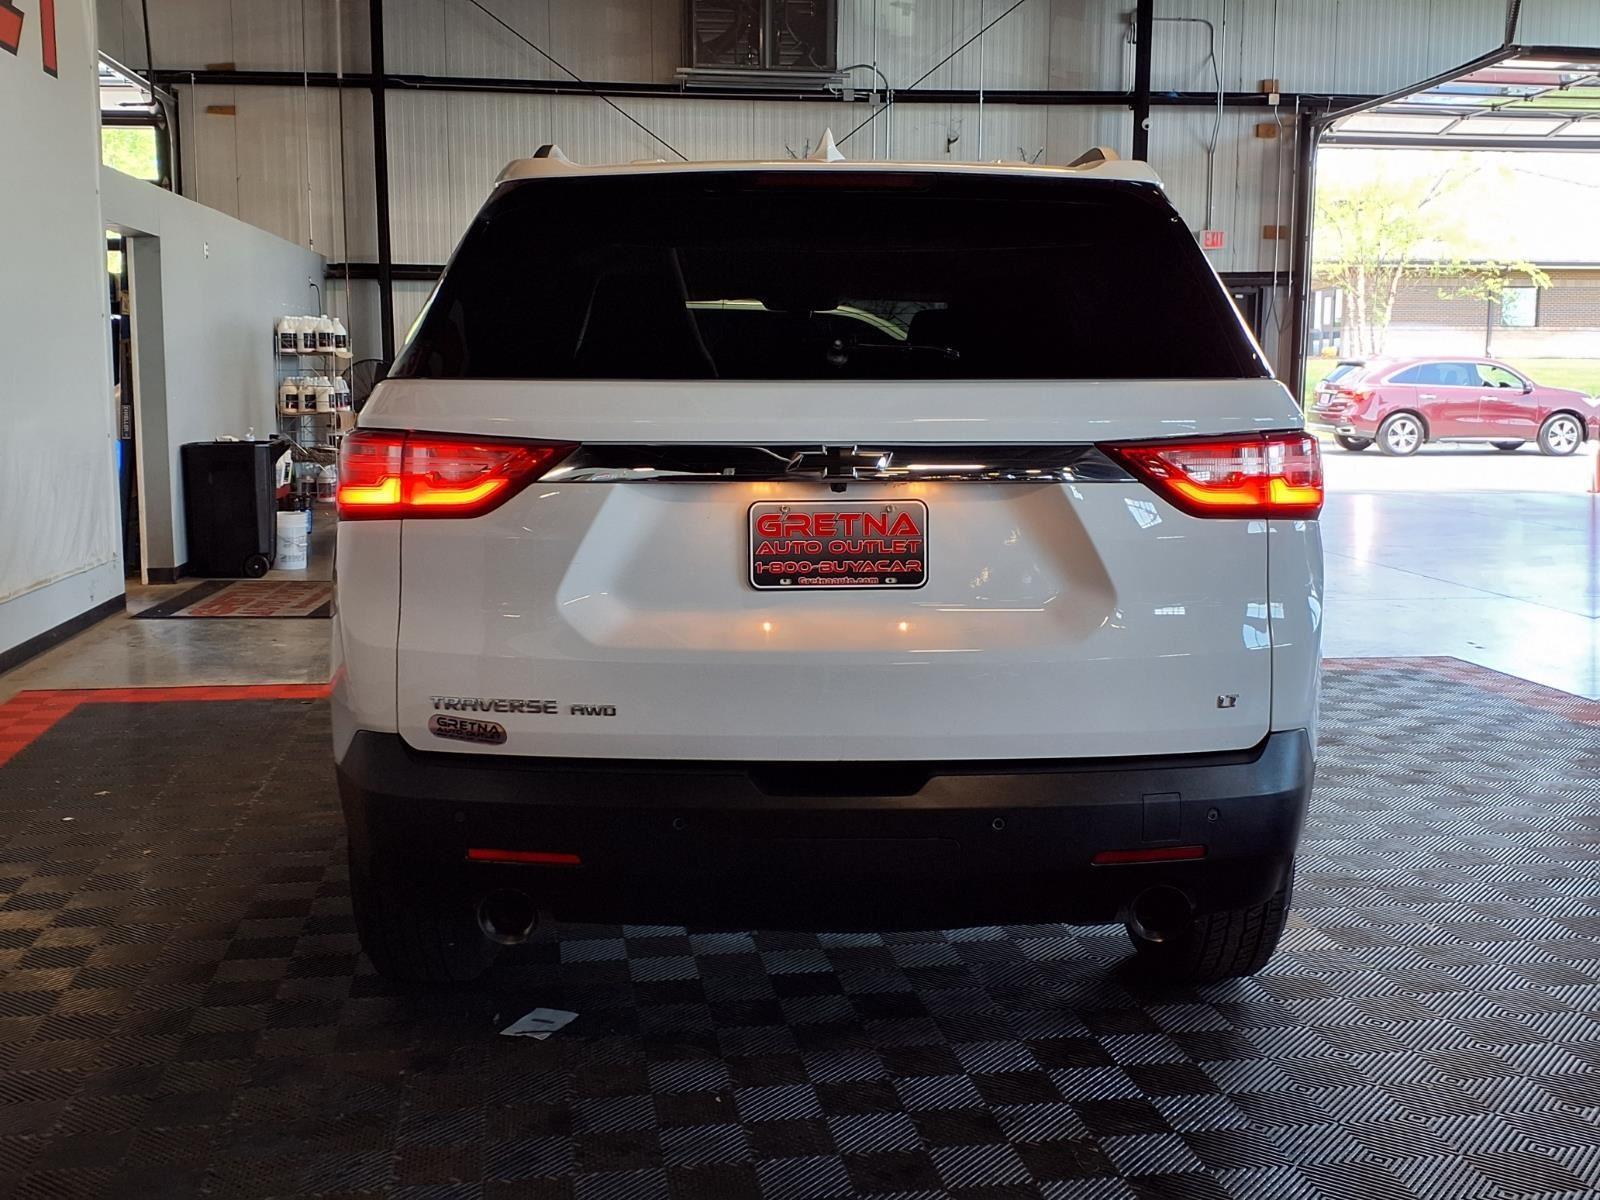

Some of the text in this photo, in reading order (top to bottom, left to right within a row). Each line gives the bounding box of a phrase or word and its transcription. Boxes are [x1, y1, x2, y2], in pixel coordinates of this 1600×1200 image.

[1204, 231, 1225, 247] EXIT
[755, 511, 921, 538] GRETNA
[755, 538, 922, 555] AUTO OUTLET
[754, 559, 922, 574] 1-800-BUYACAR
[430, 695, 617, 717] TRAVERSE AWD
[436, 716, 500, 734] GRETNA
